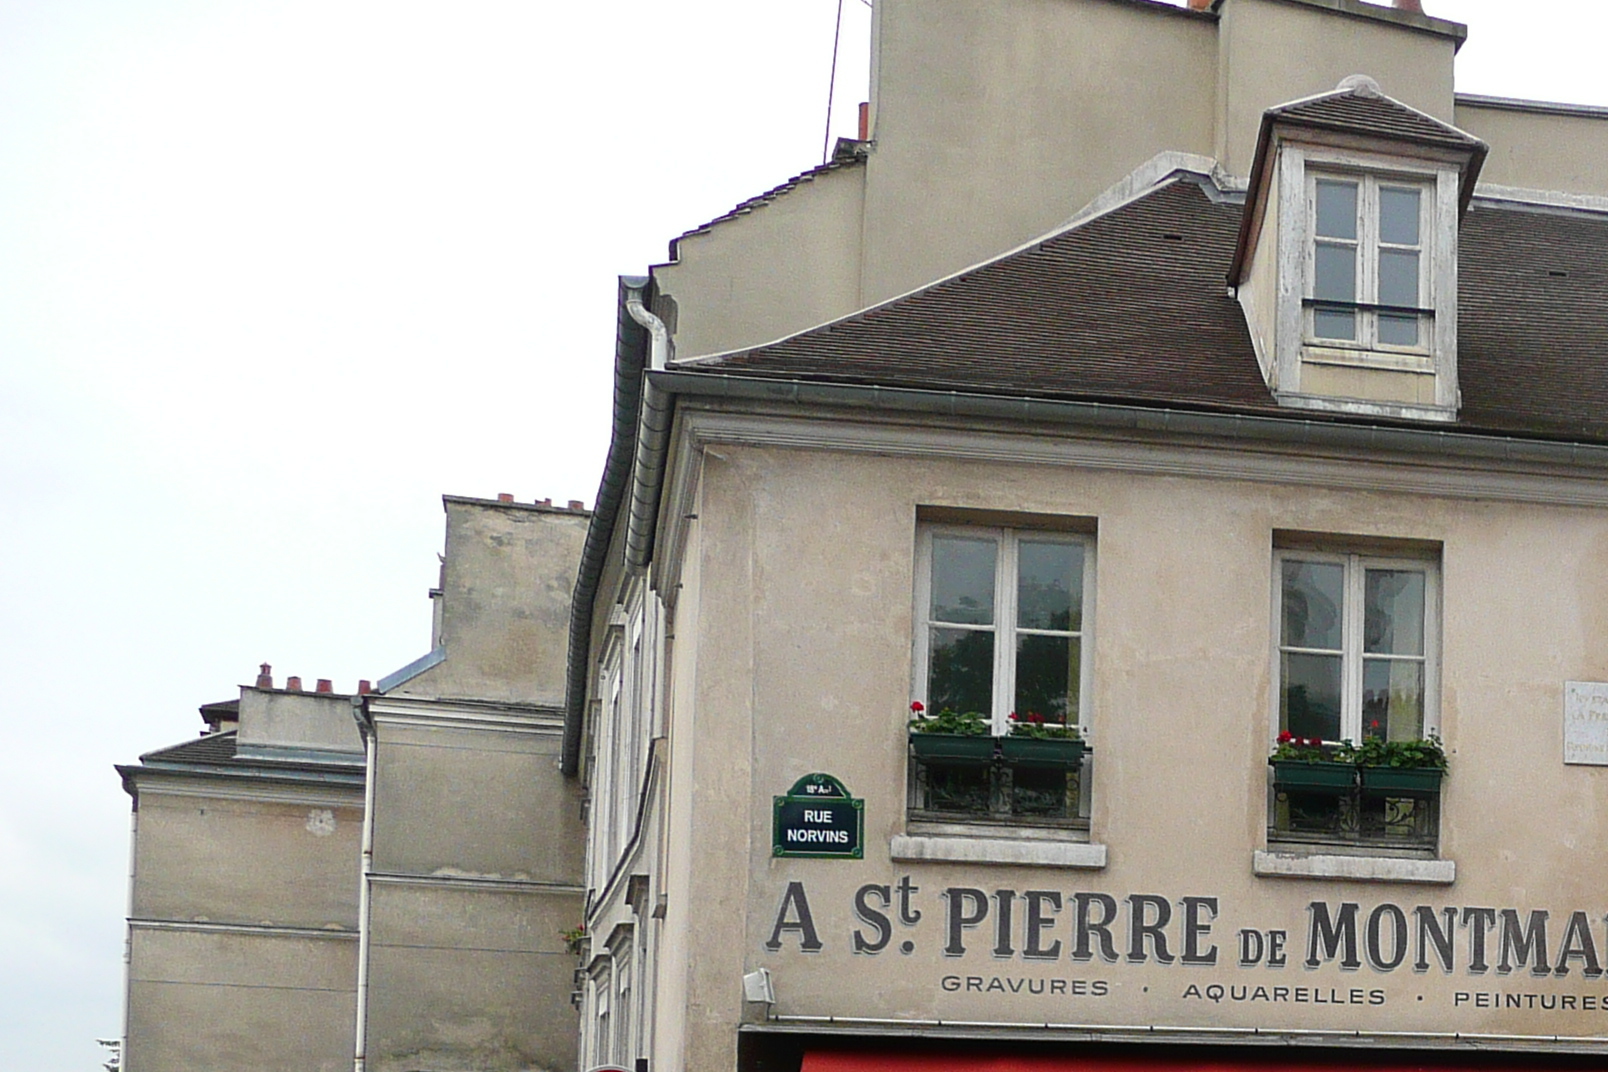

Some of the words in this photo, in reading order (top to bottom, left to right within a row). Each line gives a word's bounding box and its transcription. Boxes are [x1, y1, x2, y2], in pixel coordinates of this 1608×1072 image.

[804, 810, 833, 823] RUE
[787, 829, 849, 843] NORVINS
[765, 880, 823, 953] A
[943, 885, 1220, 966] PIERRE
[1238, 927, 1287, 968] DE
[941, 975, 1109, 996] GRAVURES
[1183, 982, 1386, 1006] AQUARELLES
